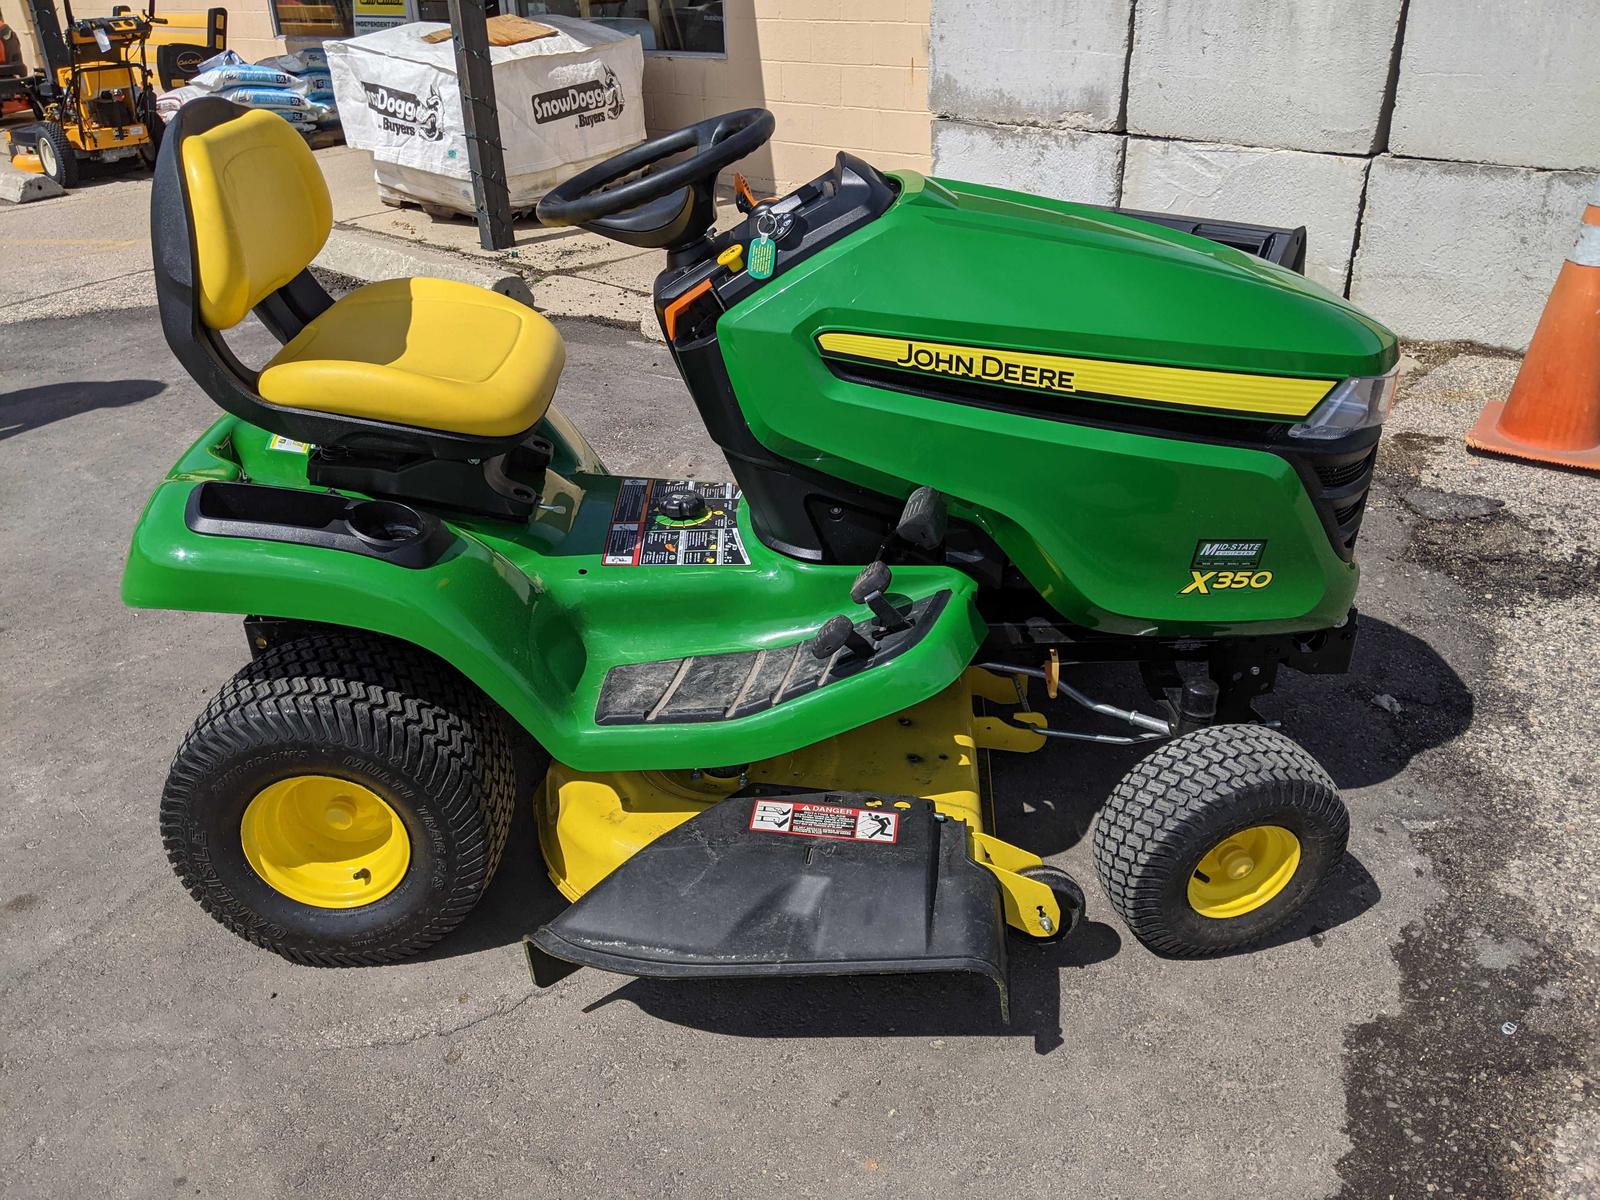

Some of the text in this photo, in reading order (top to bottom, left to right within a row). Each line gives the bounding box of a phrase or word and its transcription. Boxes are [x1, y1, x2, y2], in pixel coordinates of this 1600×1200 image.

[533, 87, 605, 120] SnowDogg
[383, 117, 416, 136] Buyers
[578, 111, 606, 128] Buyers
[897, 343, 1075, 390] JOHN DEERE
[1200, 543, 1262, 556] MID-STATE
[1178, 570, 1273, 595] X350
[812, 805, 853, 815] DANGER
